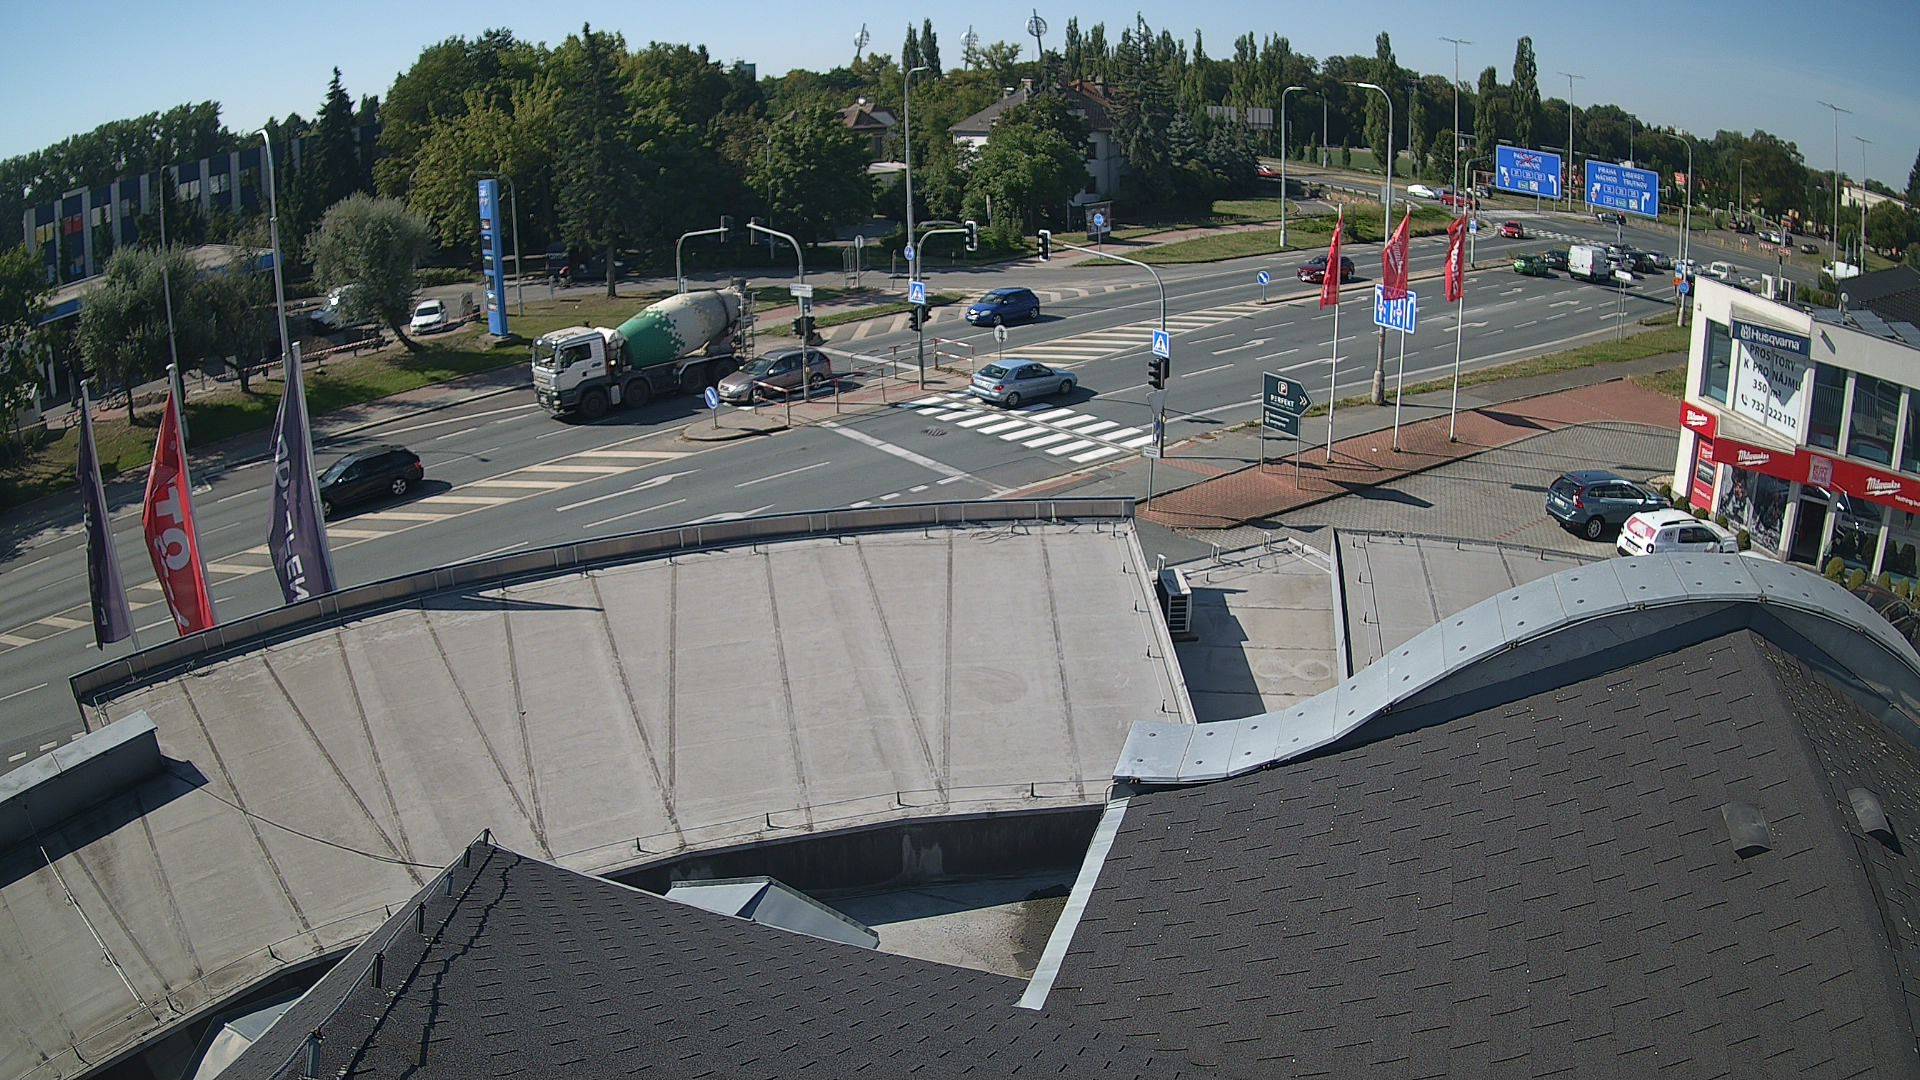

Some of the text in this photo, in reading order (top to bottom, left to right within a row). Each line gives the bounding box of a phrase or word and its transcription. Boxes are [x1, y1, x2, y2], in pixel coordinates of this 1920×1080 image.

[1751, 326, 1800, 351] Husqvarna
[1743, 358, 1749, 370] K
[1753, 379, 1767, 393] 350
[1751, 399, 1765, 413] 732
